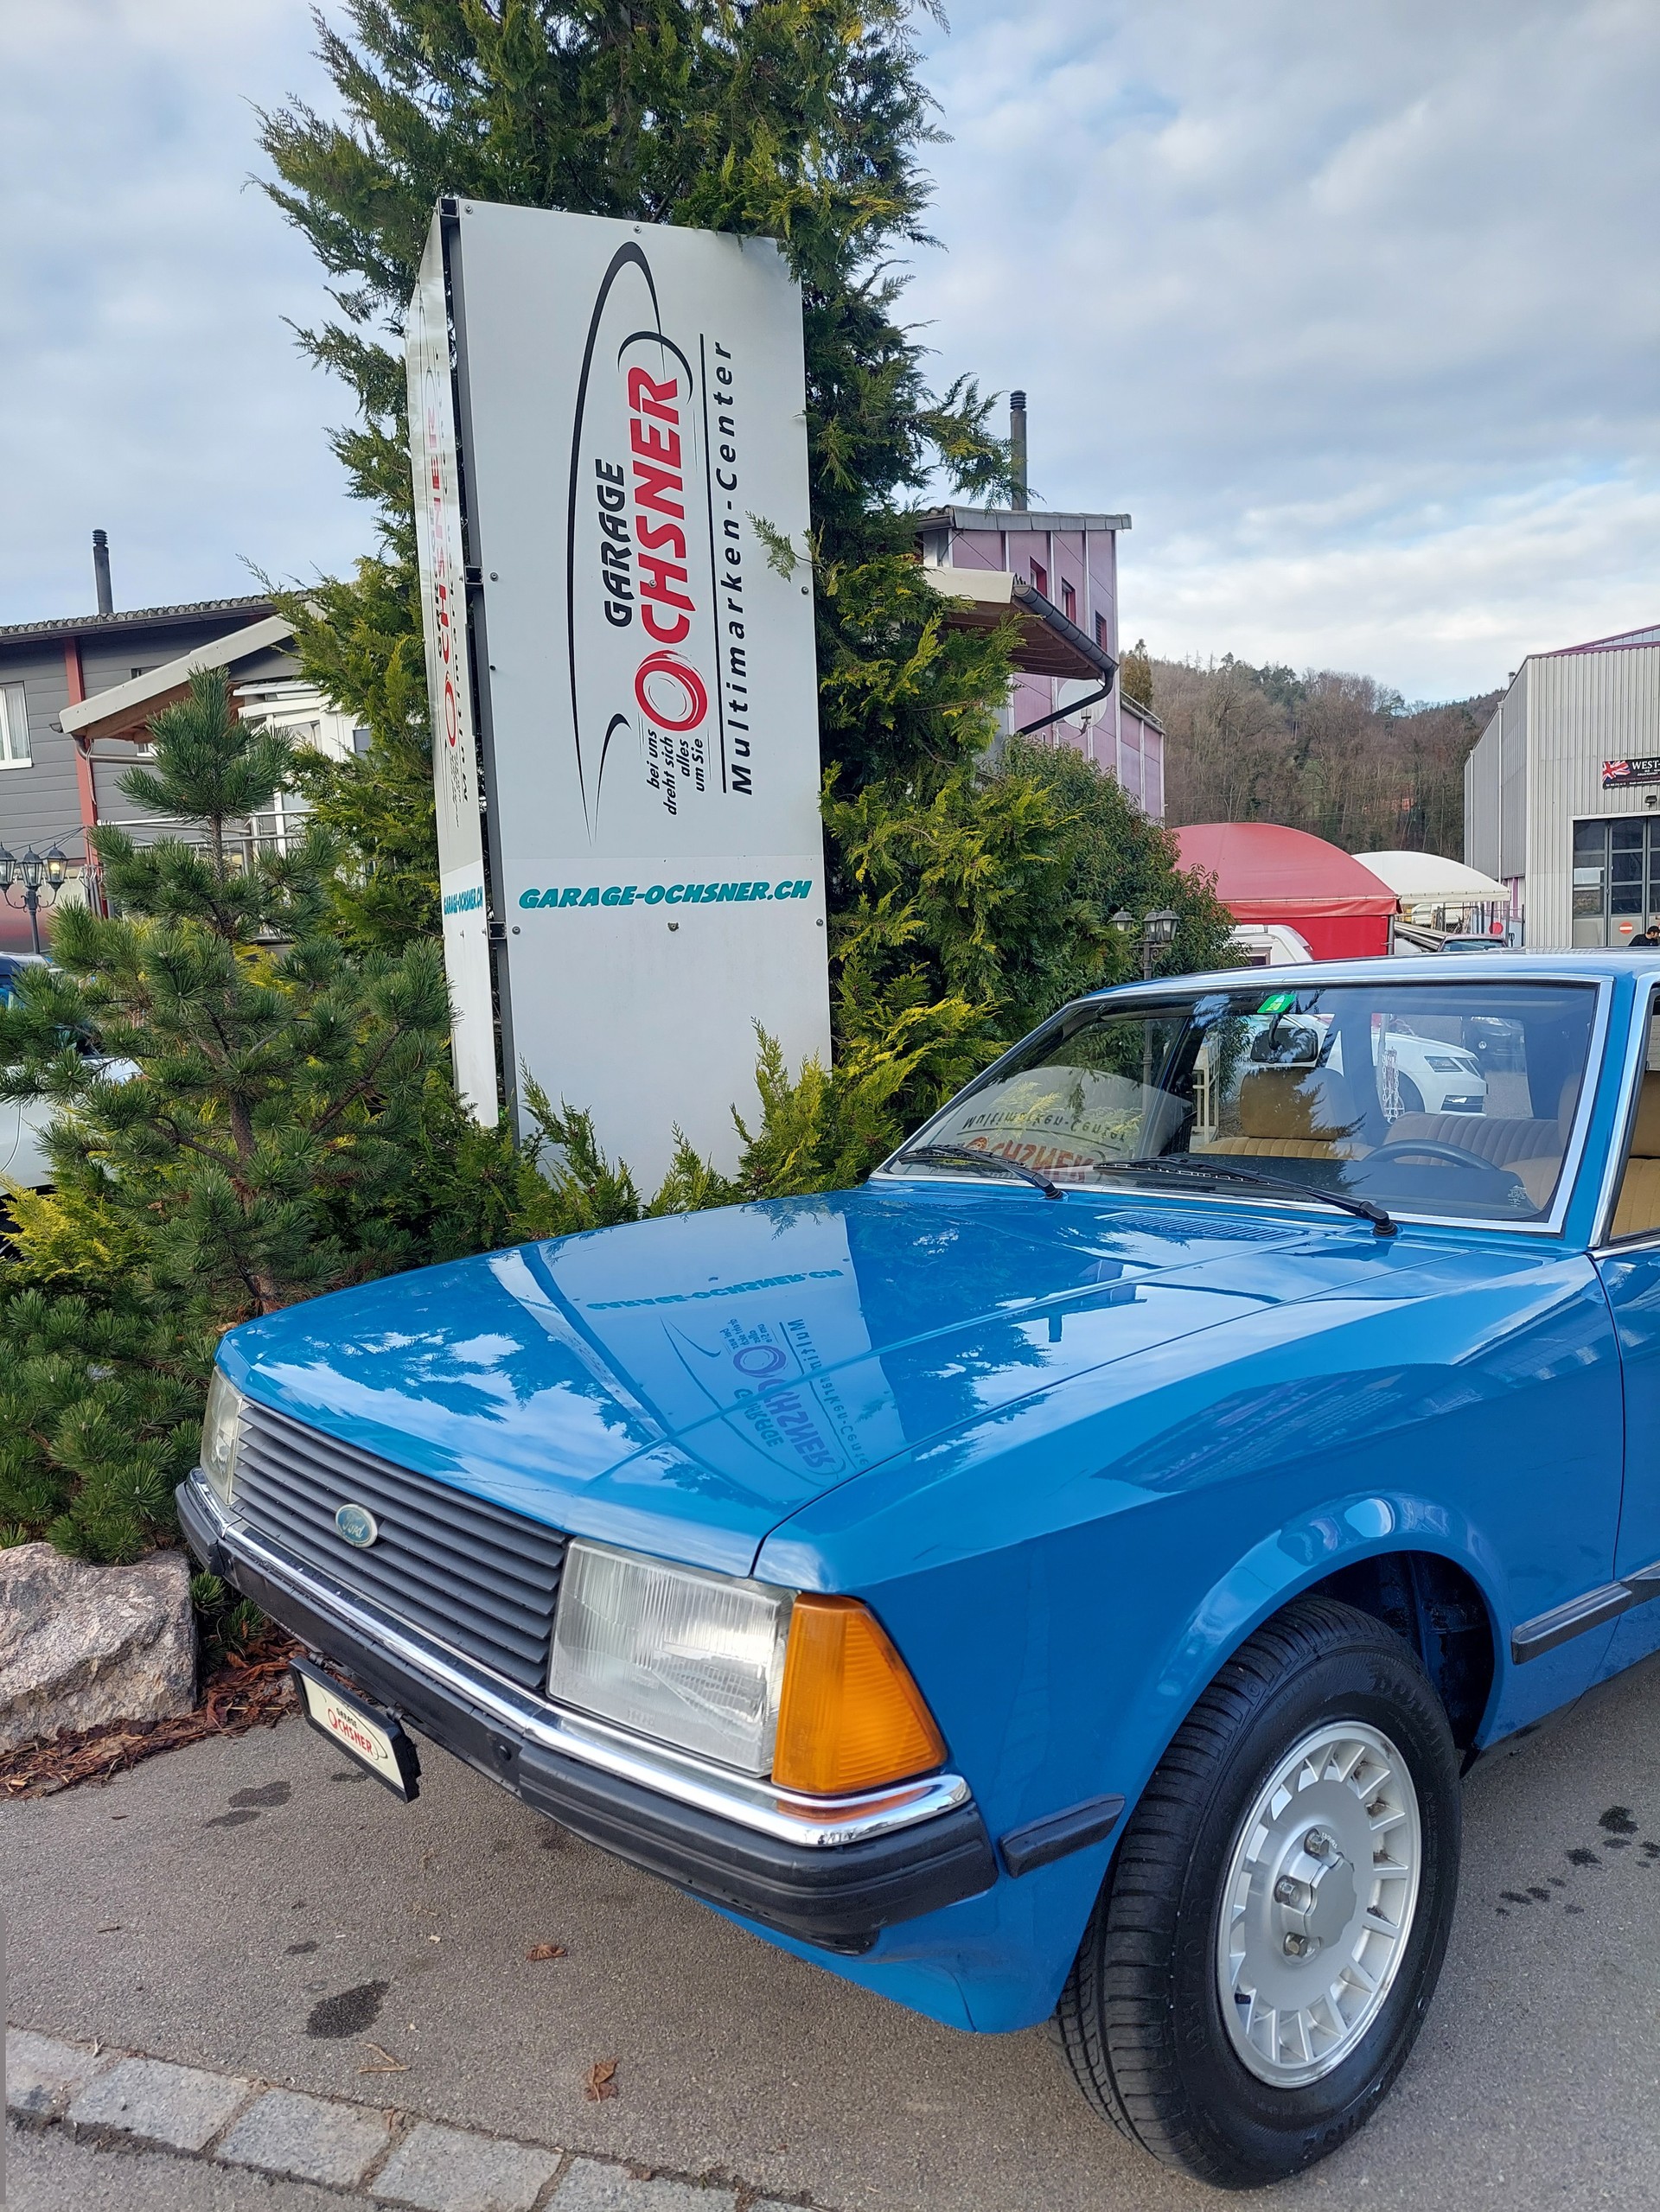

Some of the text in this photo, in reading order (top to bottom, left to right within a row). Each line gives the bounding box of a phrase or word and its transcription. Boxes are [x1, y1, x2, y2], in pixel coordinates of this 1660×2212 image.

[595, 457, 633, 628] GARAGE
[627, 366, 709, 732] OCHSNER
[713, 341, 753, 796] Multimarken-Center
[646, 728, 660, 790] bei uns
[659, 736, 678, 816] dreht sich
[675, 738, 691, 777] alles
[690, 738, 706, 793] um Sie
[519, 880, 814, 909] GARAGE-OCHSNER.CH
[342, 1513, 366, 1539] Ford
[327, 1707, 374, 1756] OCHSNER
